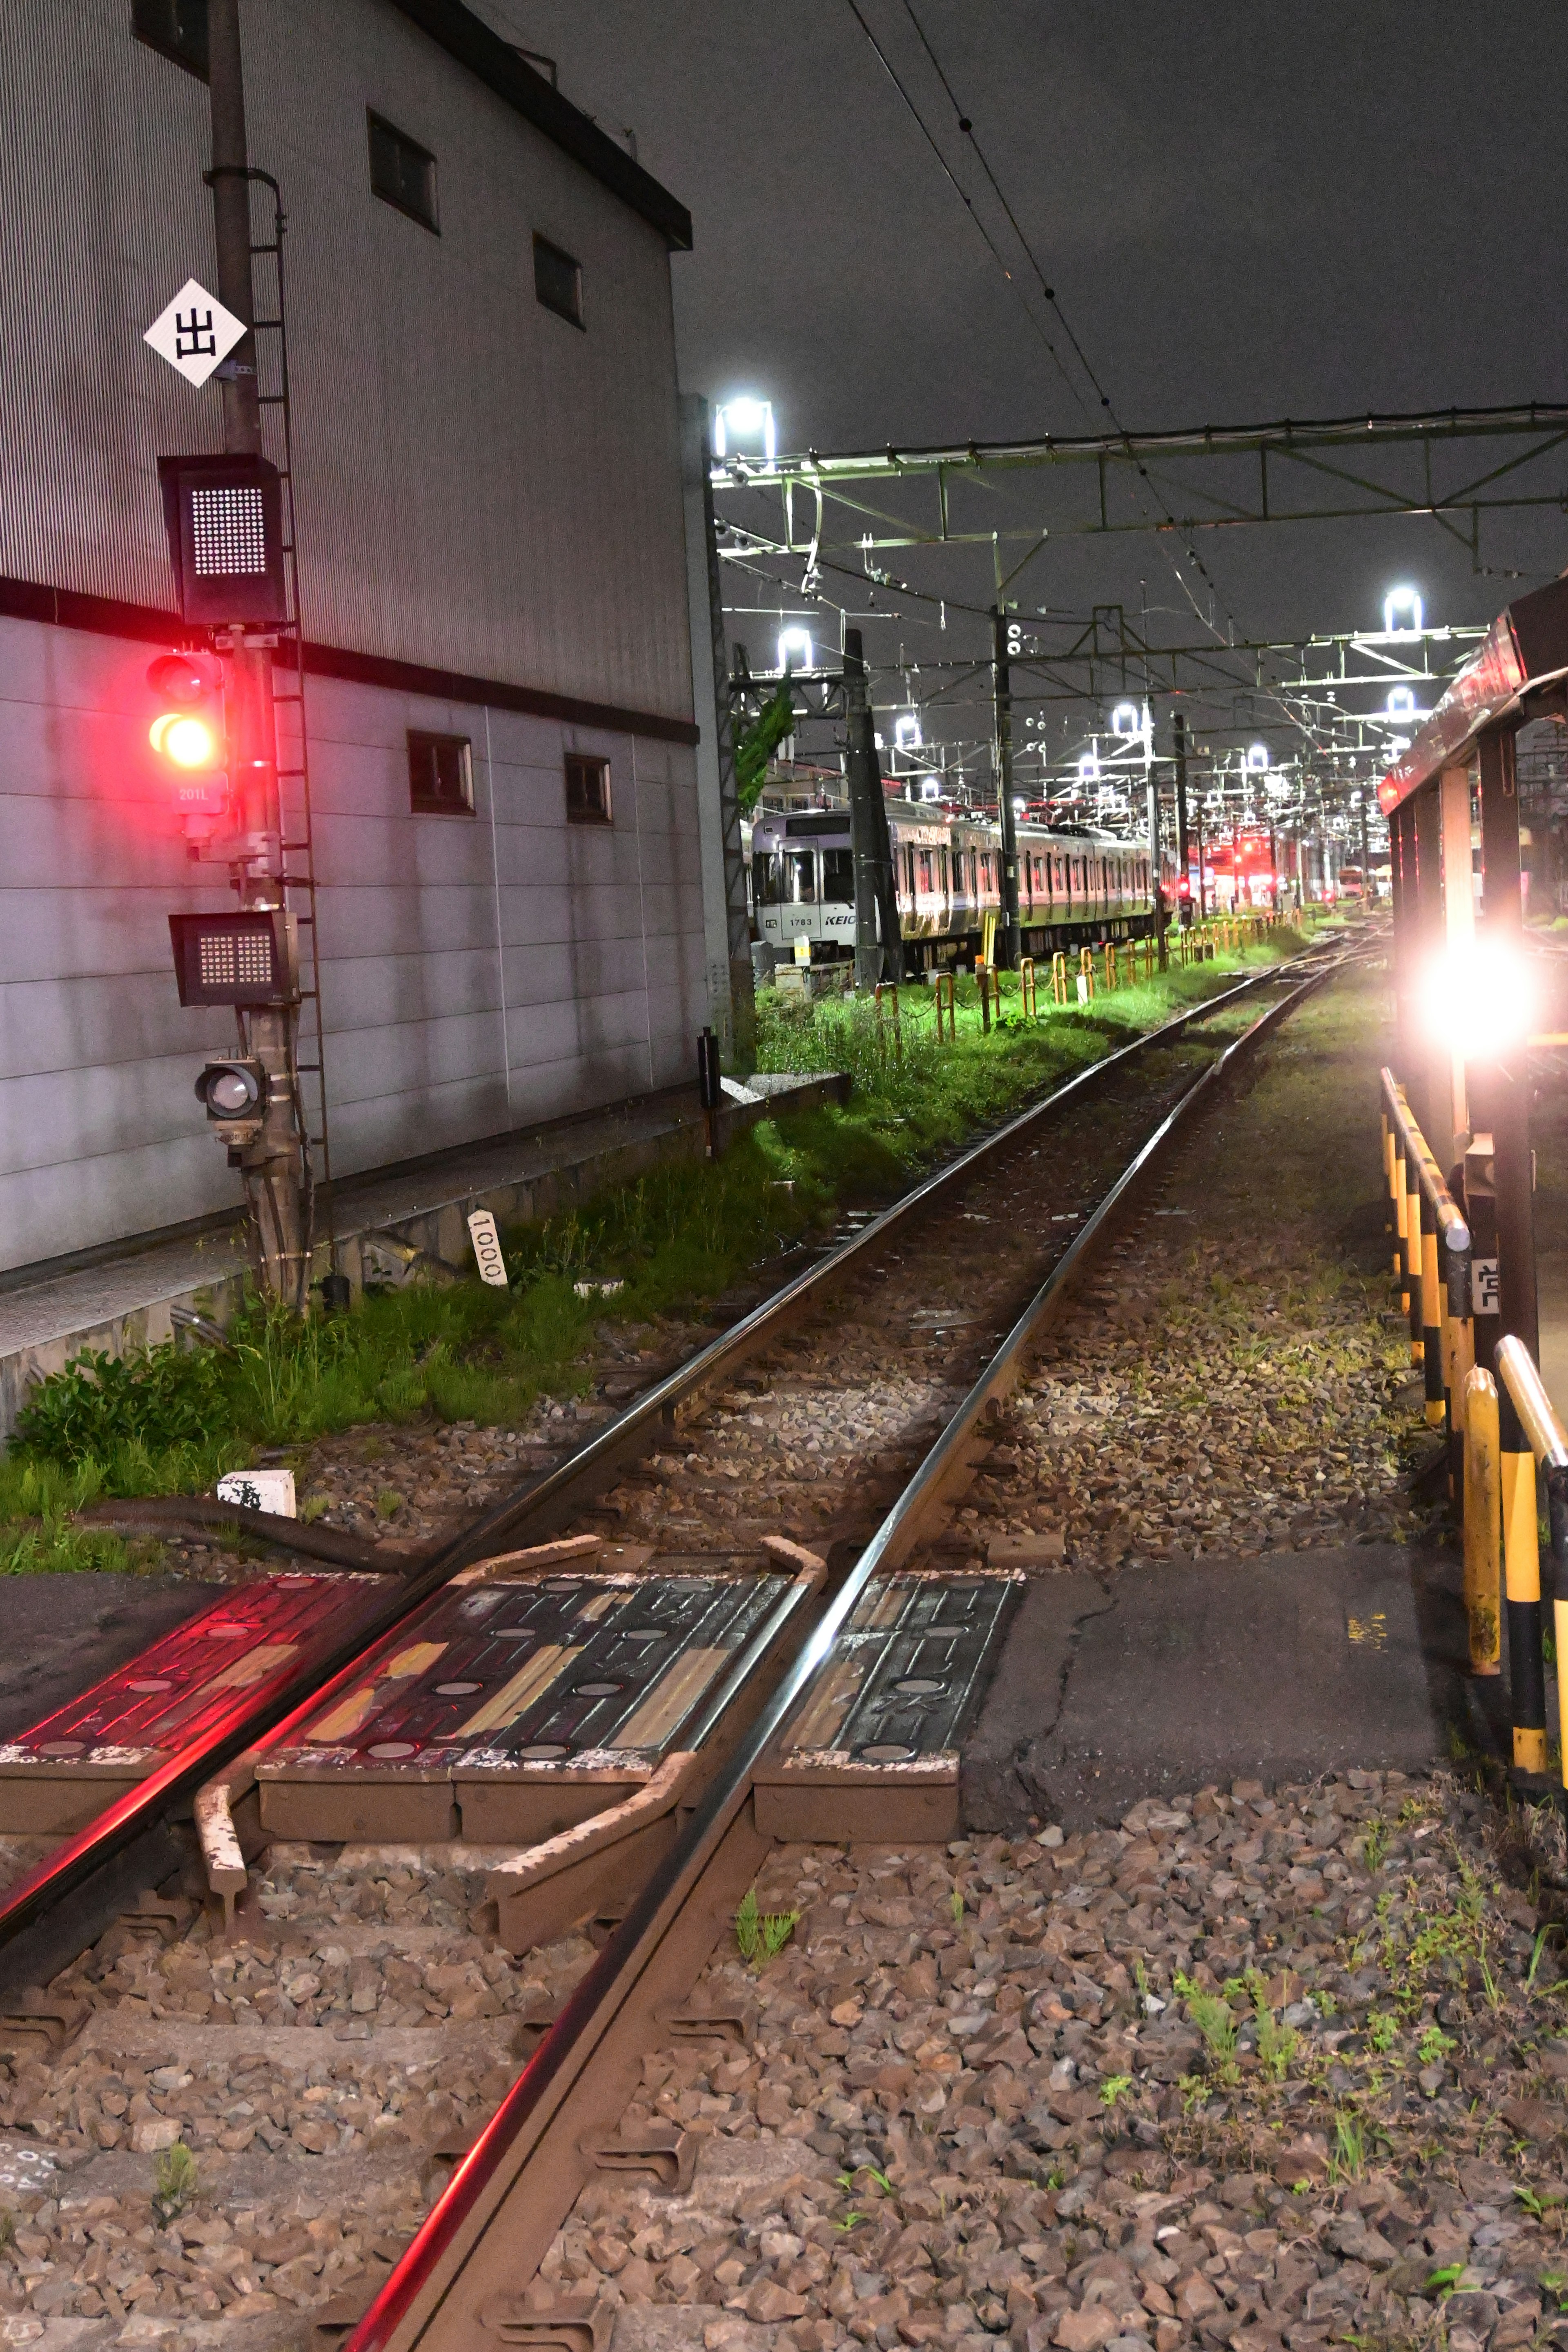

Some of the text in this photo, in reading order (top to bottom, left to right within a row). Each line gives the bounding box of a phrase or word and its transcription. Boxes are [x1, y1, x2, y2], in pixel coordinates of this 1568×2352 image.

[176, 308, 216, 359] 出
[180, 788, 209, 800] 201L
[473, 1218, 501, 1277] 1000
